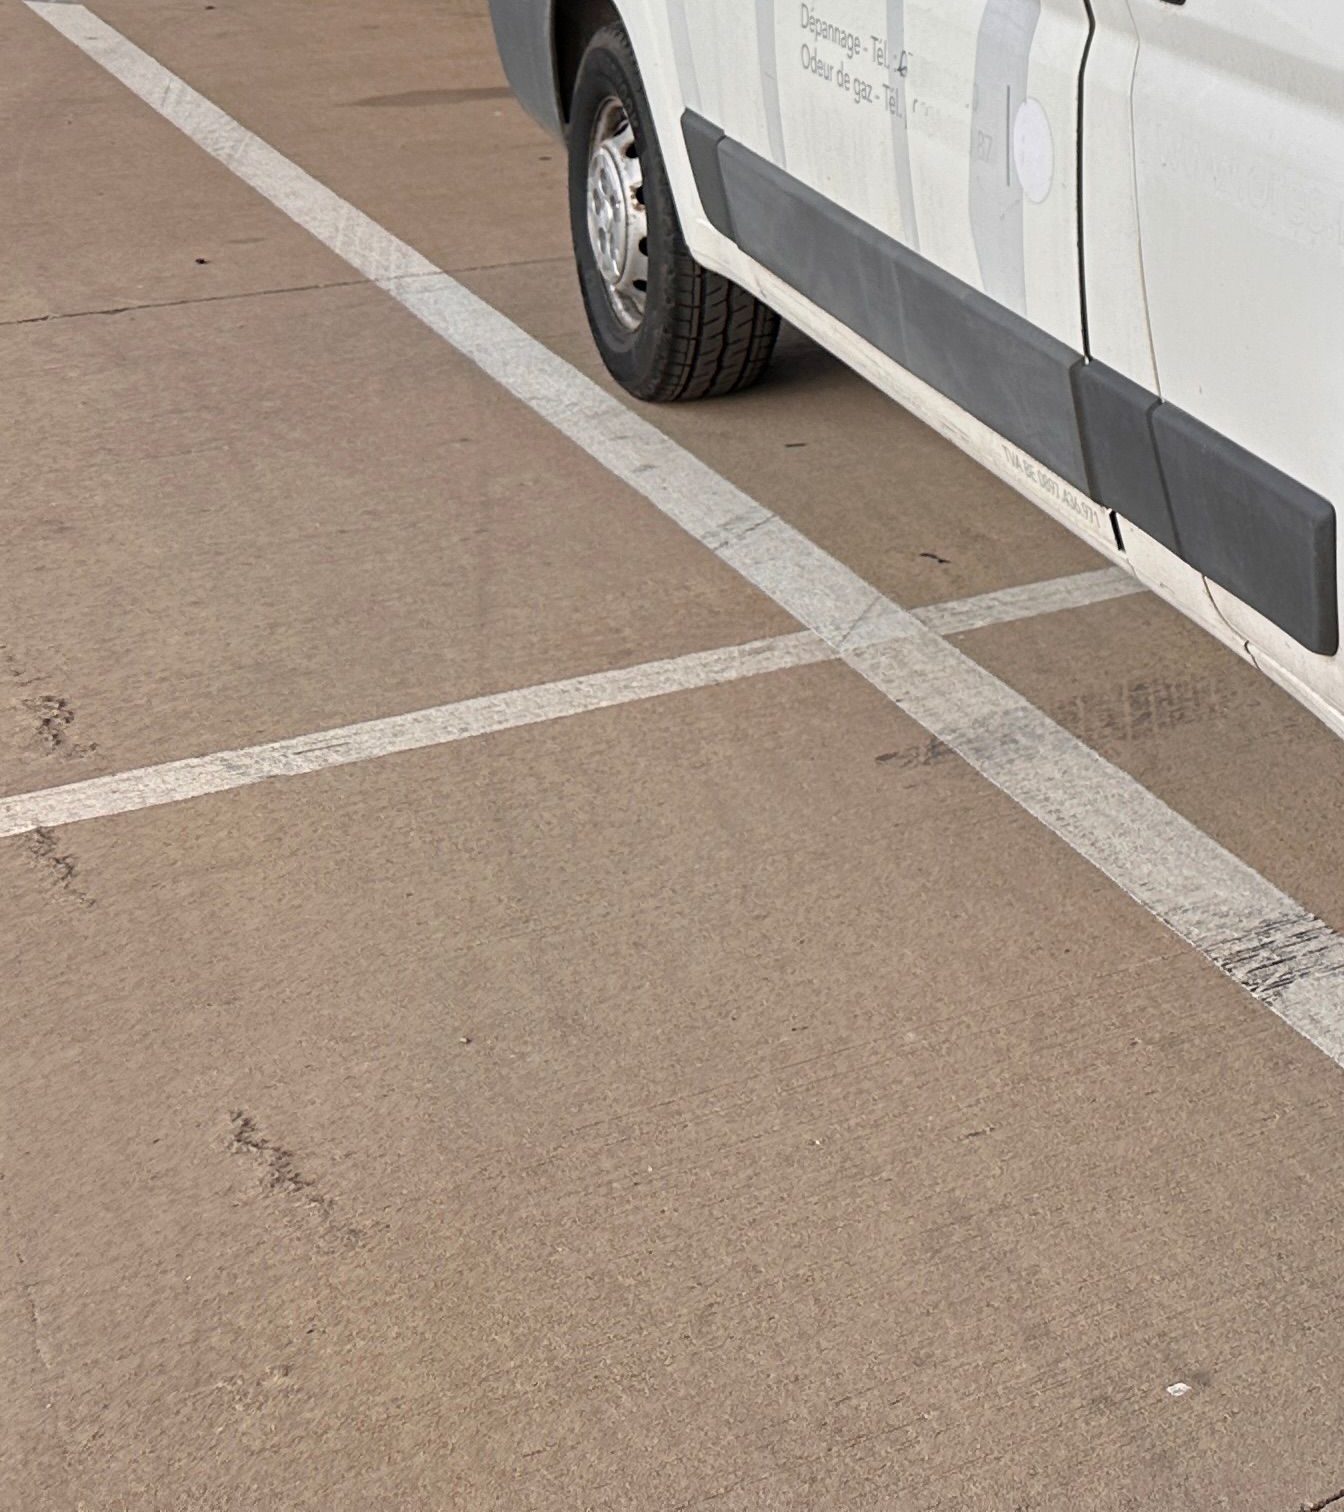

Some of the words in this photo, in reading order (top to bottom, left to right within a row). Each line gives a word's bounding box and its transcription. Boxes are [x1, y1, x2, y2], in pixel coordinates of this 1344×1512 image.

[800, 2, 861, 59] Dépannage
[801, 43, 834, 82] Odeur
[836, 60, 851, 92] de
[853, 77, 874, 105] gaz
